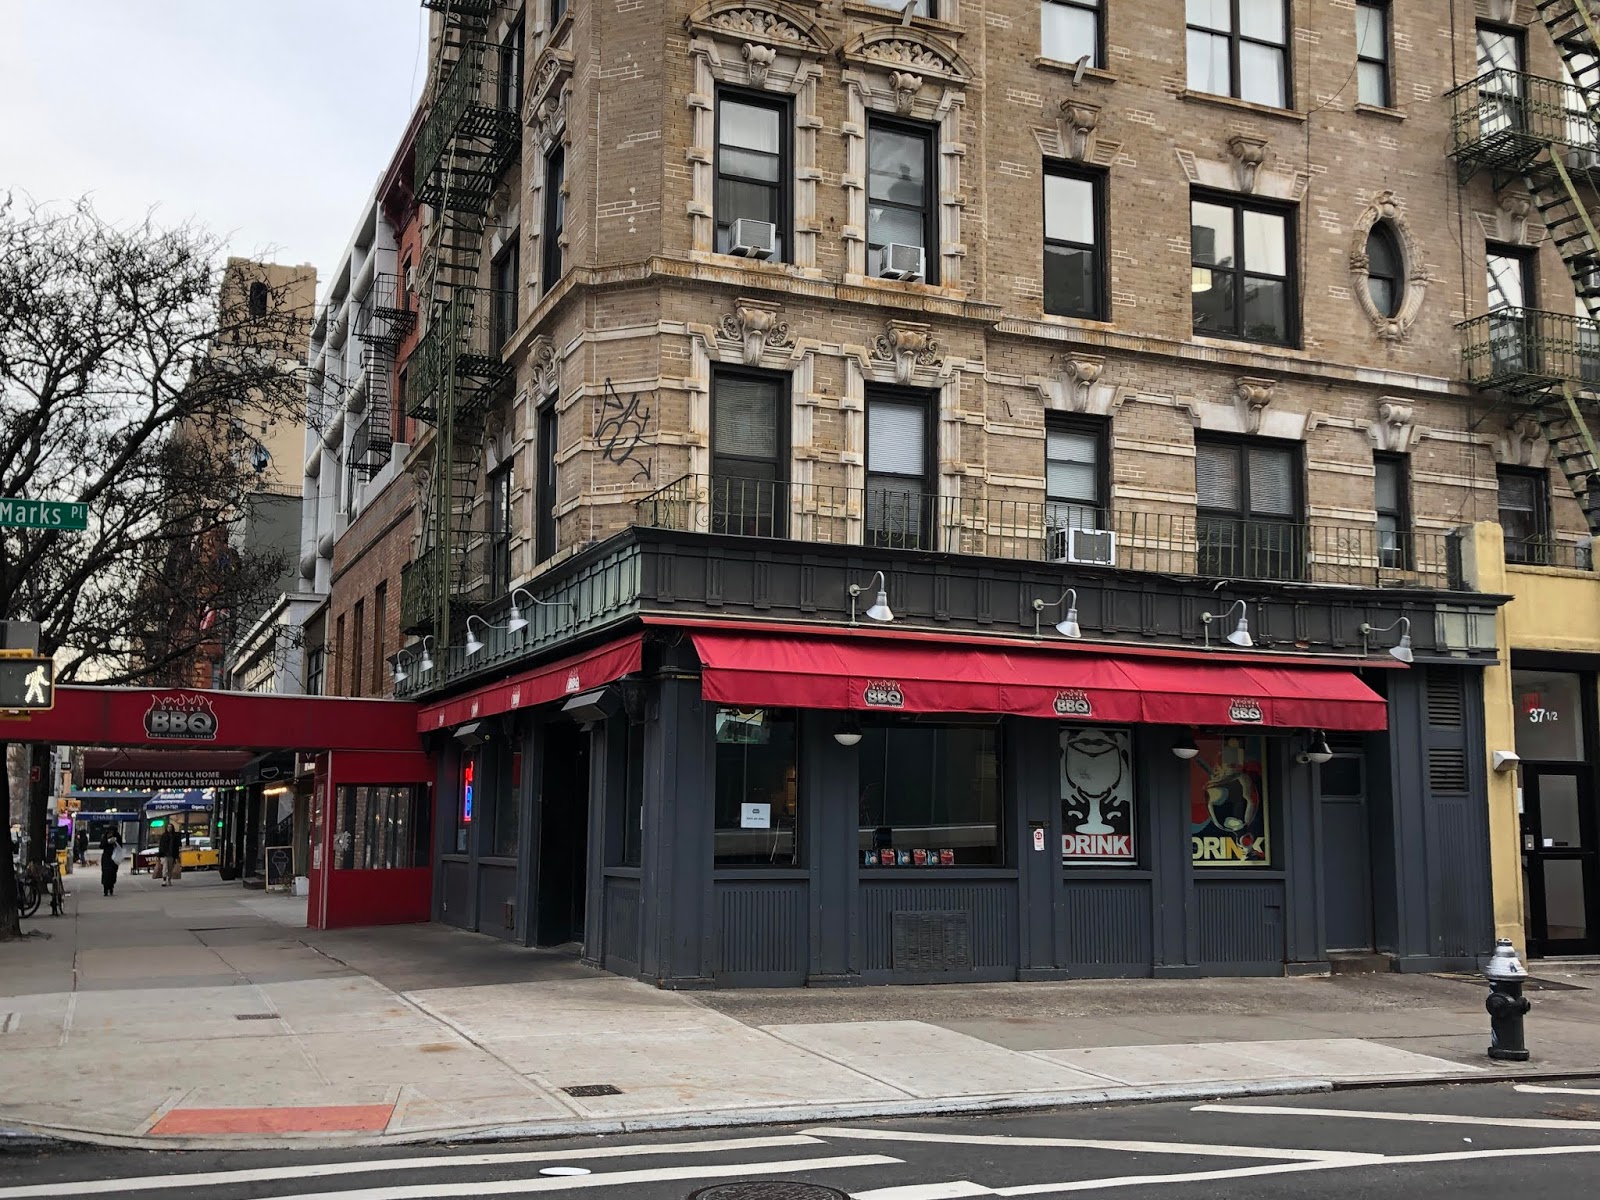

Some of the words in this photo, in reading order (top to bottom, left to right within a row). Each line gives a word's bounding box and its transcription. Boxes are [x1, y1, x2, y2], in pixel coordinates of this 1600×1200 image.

[0, 502, 61, 525] Marks
[71, 505, 83, 519] Pl
[868, 690, 901, 703] BBQ
[1057, 699, 1088, 712] BBQ
[1232, 707, 1260, 719] BBQ
[1530, 708, 1546, 722] 37
[1546, 711, 1558, 721] 1/2
[151, 711, 212, 734] BBQ
[1062, 834, 1130, 854] DRINK
